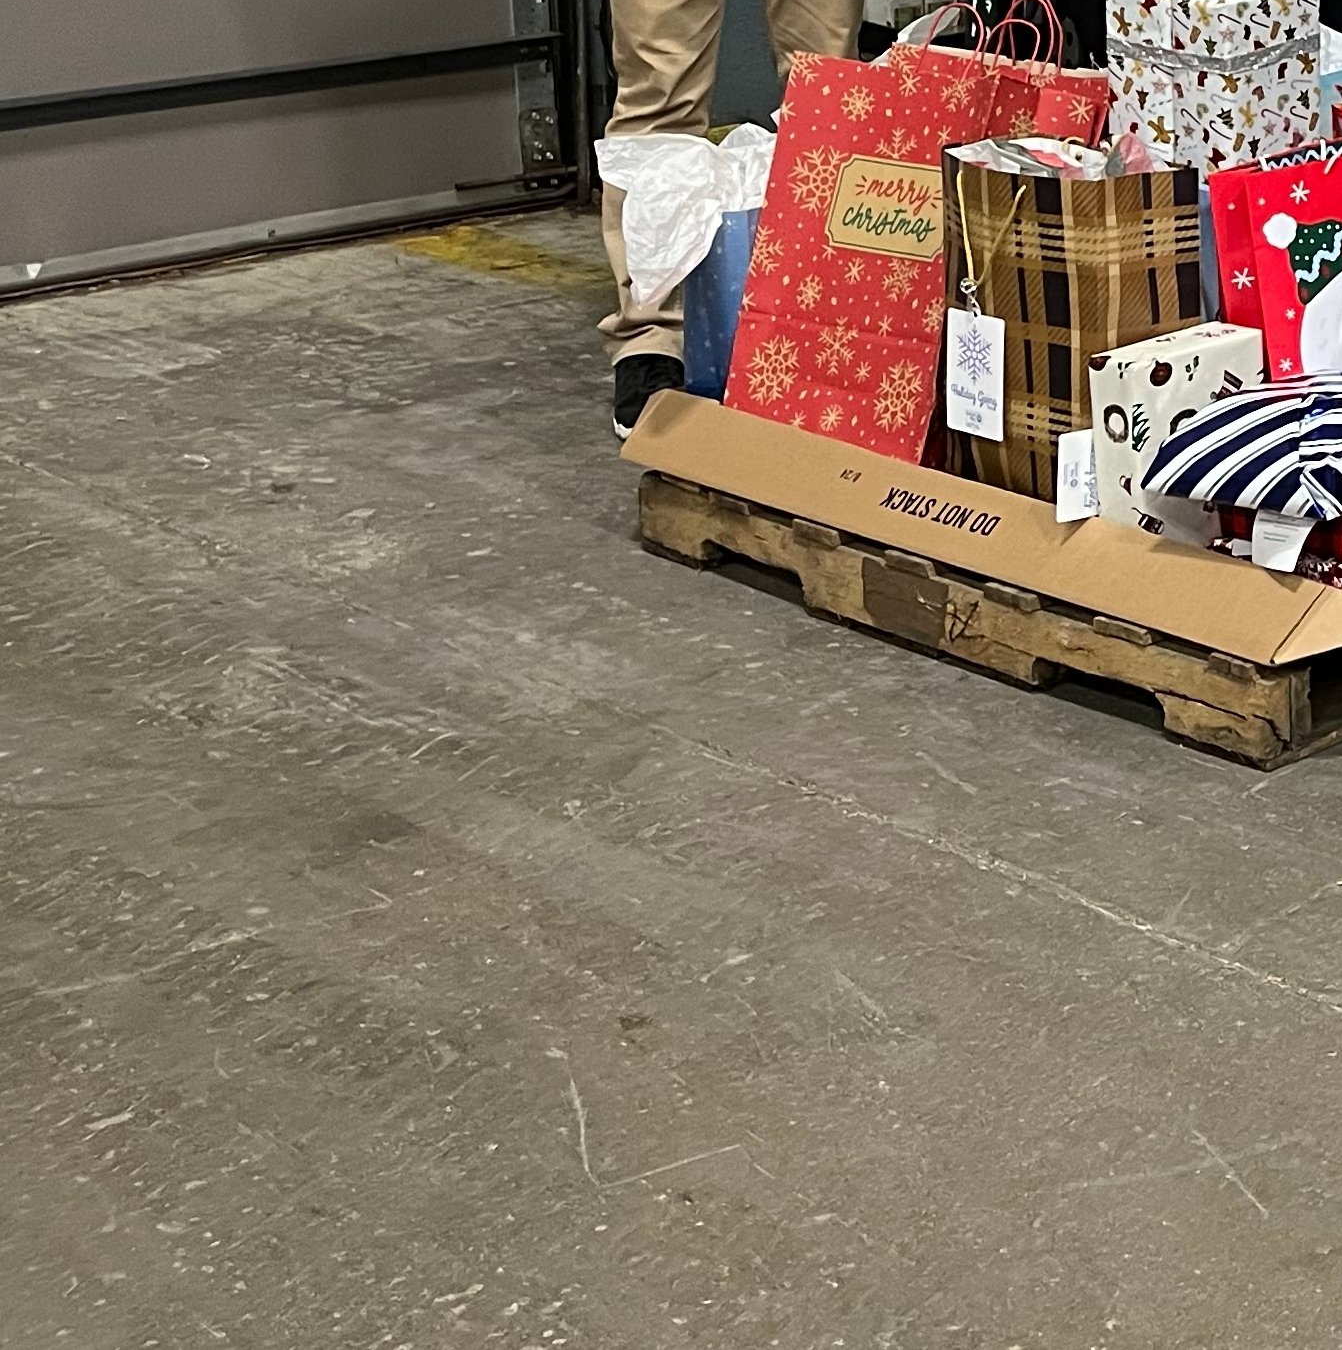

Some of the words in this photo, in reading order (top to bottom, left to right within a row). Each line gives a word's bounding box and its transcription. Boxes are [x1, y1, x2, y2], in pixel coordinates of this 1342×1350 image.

[866, 178, 931, 217] merry
[842, 202, 937, 243] christmas
[878, 486, 938, 518] STACK
[931, 502, 975, 529] NOT
[969, 512, 1002, 536] DO
